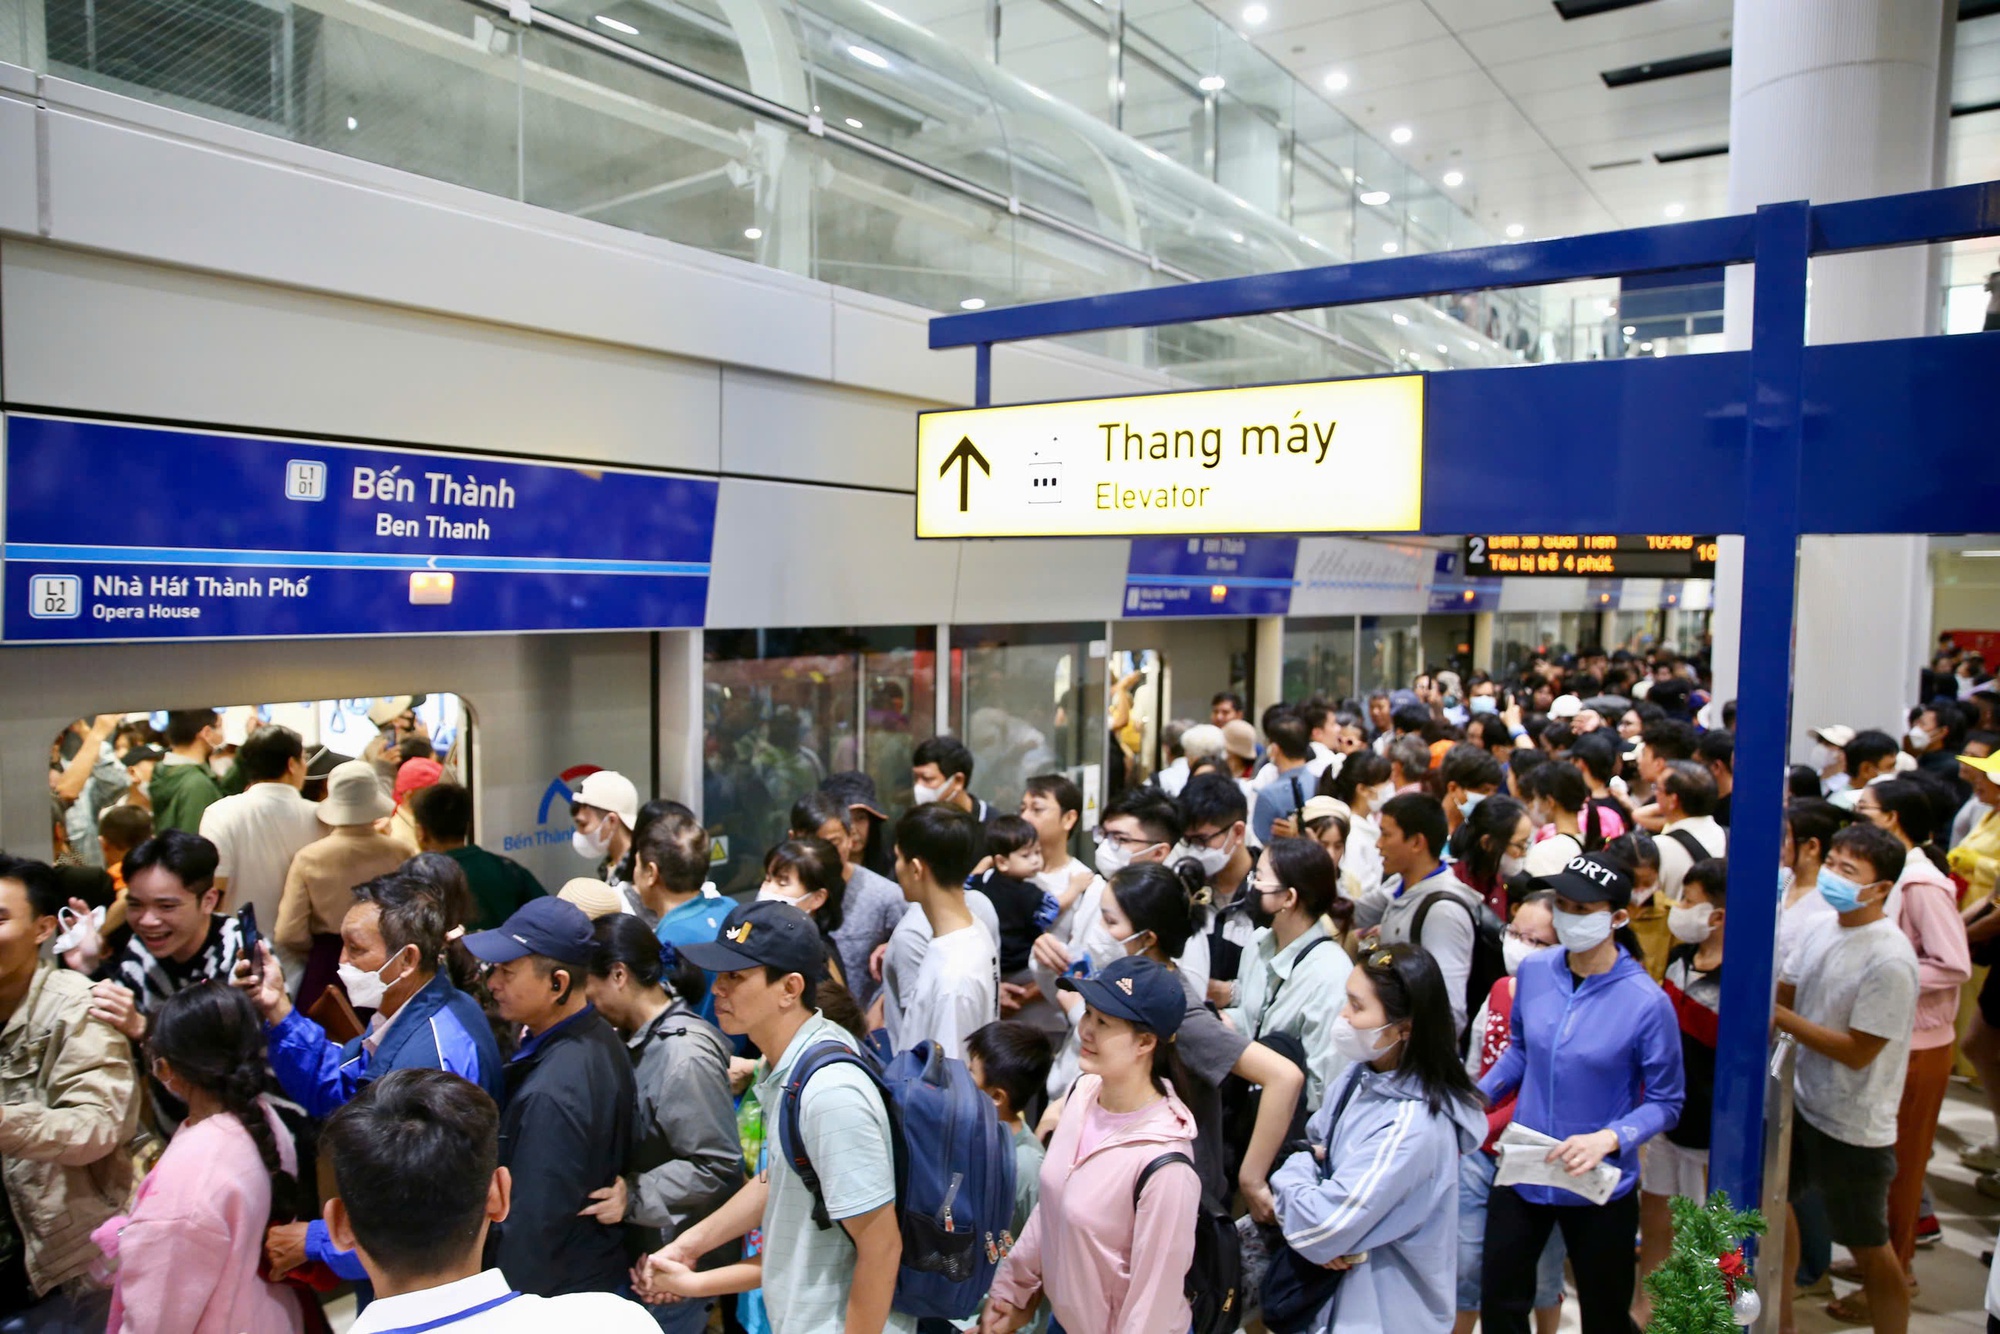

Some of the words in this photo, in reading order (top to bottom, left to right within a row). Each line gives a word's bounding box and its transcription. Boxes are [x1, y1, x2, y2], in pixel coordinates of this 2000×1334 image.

[1098, 423, 1221, 468] Thang
[1242, 410, 1336, 464] máy
[299, 465, 314, 480] L1
[299, 480, 314, 495] 01
[352, 465, 415, 503] Bến
[424, 471, 515, 508] Thành
[1096, 483, 1211, 509] Elevator
[376, 513, 419, 538] Ben
[425, 515, 491, 540] Thanh
[1468, 537, 1486, 563] 2
[1563, 554, 1576, 571] 4
[46, 581, 66, 597] L1
[93, 575, 143, 598] Nhà
[150, 576, 189, 598] Hát
[195, 576, 263, 598] Thành
[269, 575, 312, 598] Phố
[45, 598, 66, 613] 02
[93, 604, 145, 623] Opera
[149, 605, 201, 619] House
